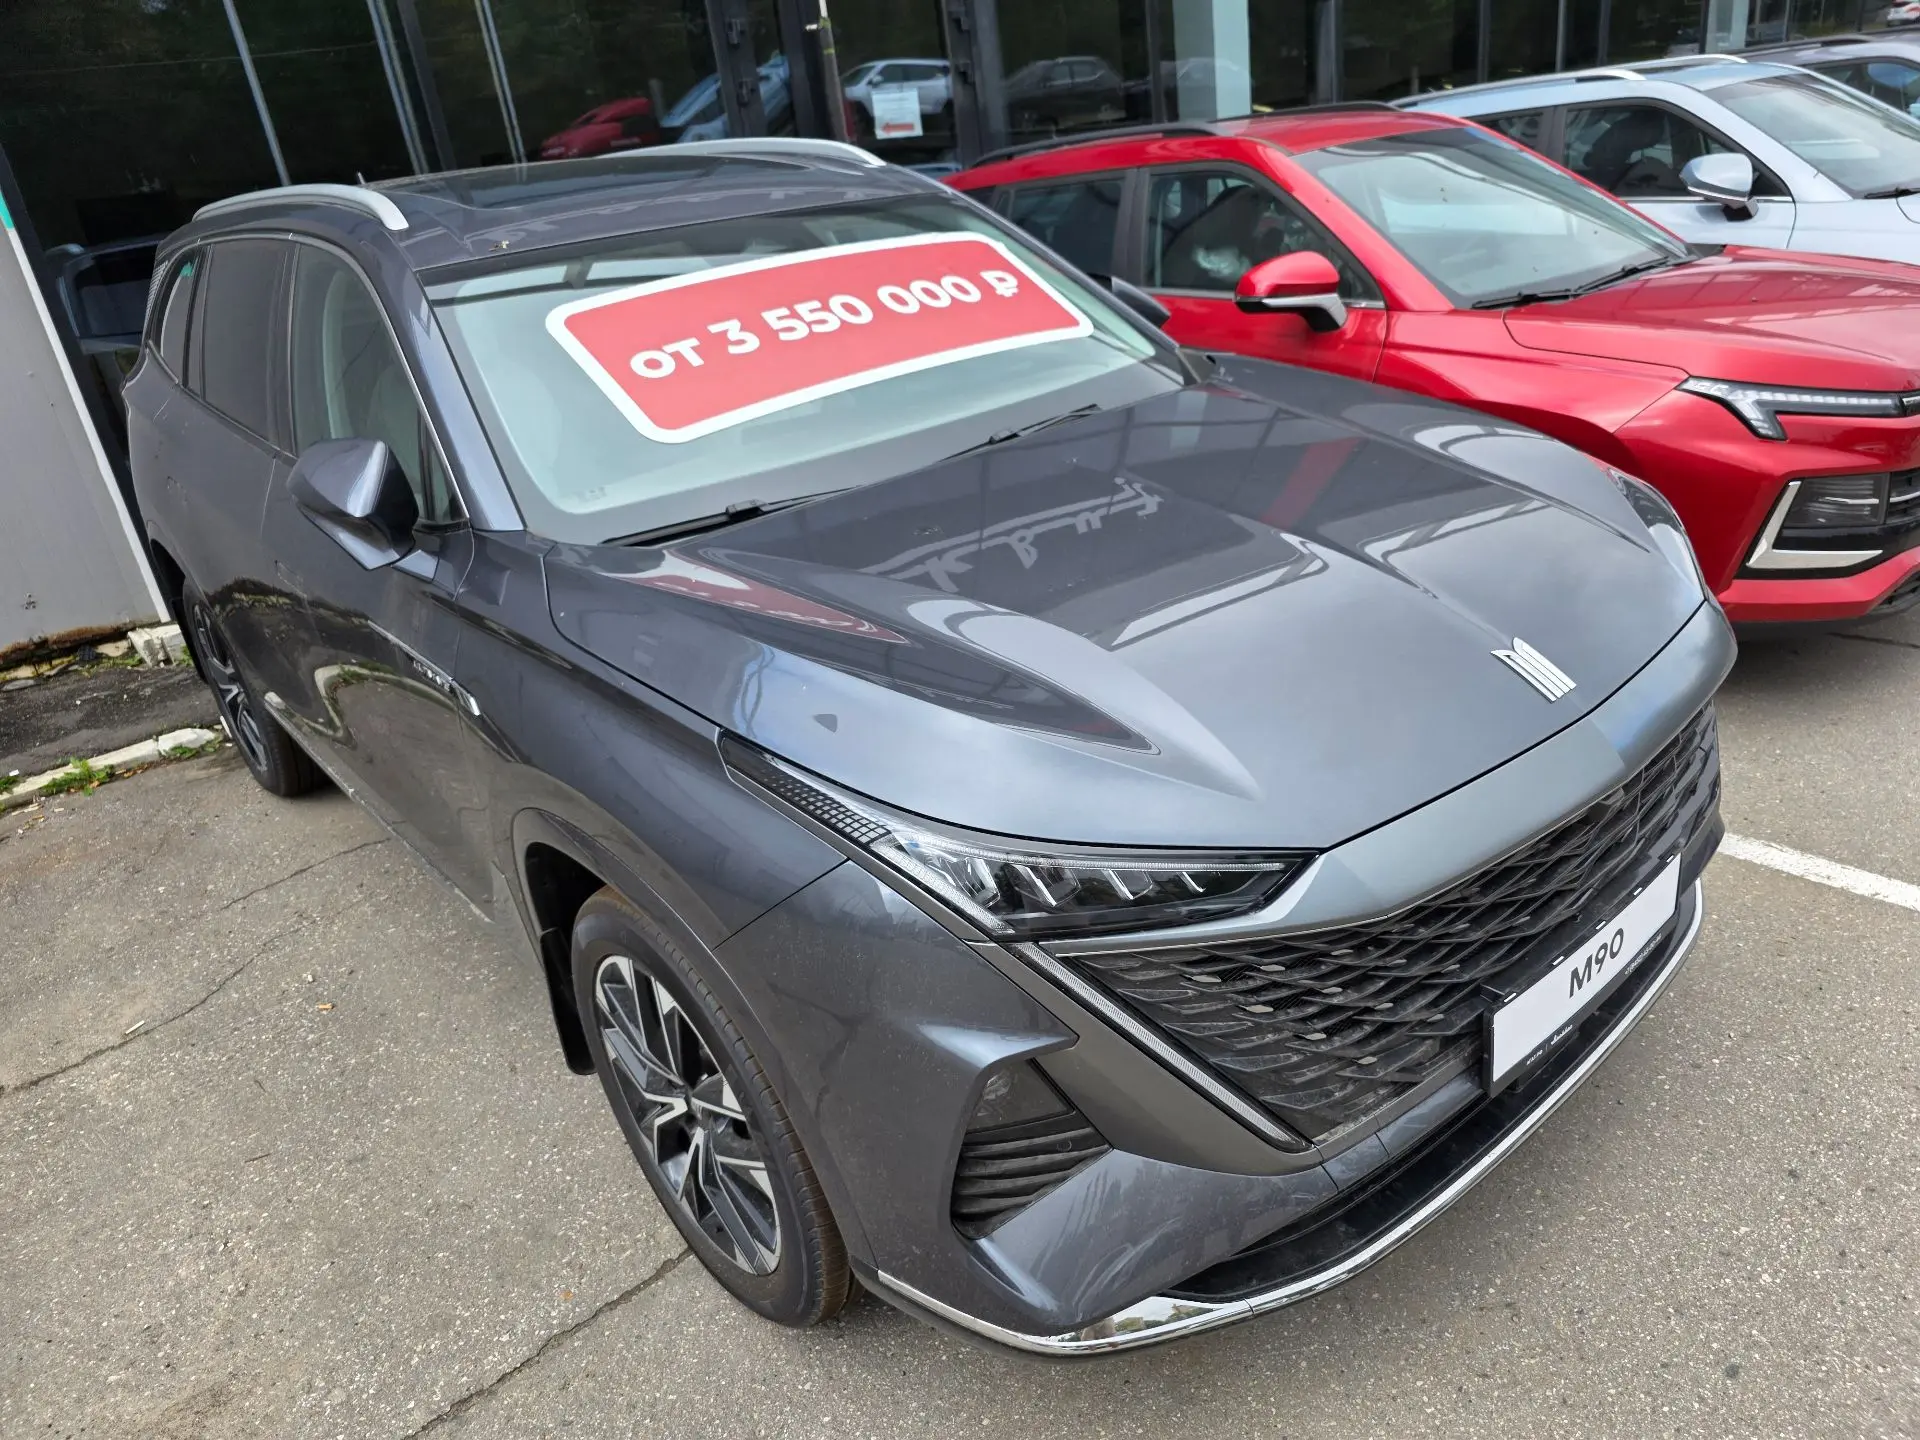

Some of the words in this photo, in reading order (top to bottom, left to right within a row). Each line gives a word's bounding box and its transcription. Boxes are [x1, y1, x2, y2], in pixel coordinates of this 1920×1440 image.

[707, 319, 760, 354] 3
[761, 294, 873, 341] 550
[876, 275, 981, 315] 000
[980, 270, 1019, 298] ₽
[1569, 928, 1625, 999] M90
